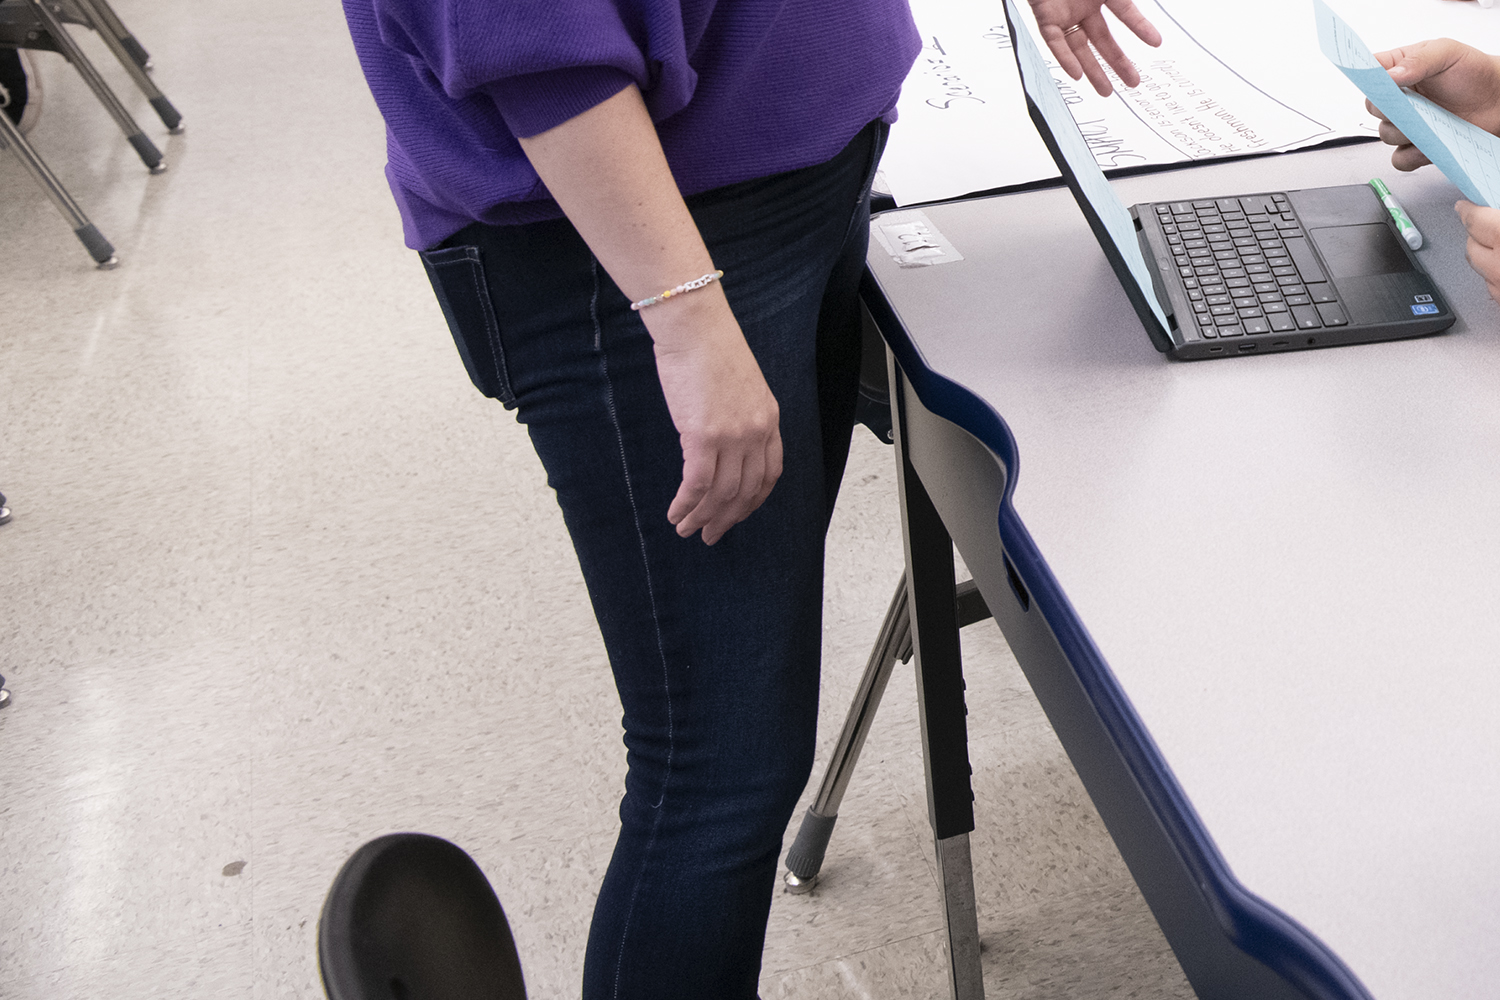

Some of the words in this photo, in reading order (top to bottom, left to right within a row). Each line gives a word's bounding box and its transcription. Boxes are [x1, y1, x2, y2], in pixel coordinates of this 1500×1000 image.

[1154, 91, 1172, 101] to
[1164, 100, 1188, 116] like
[1195, 97, 1219, 113] He
[1219, 142, 1242, 153] He
